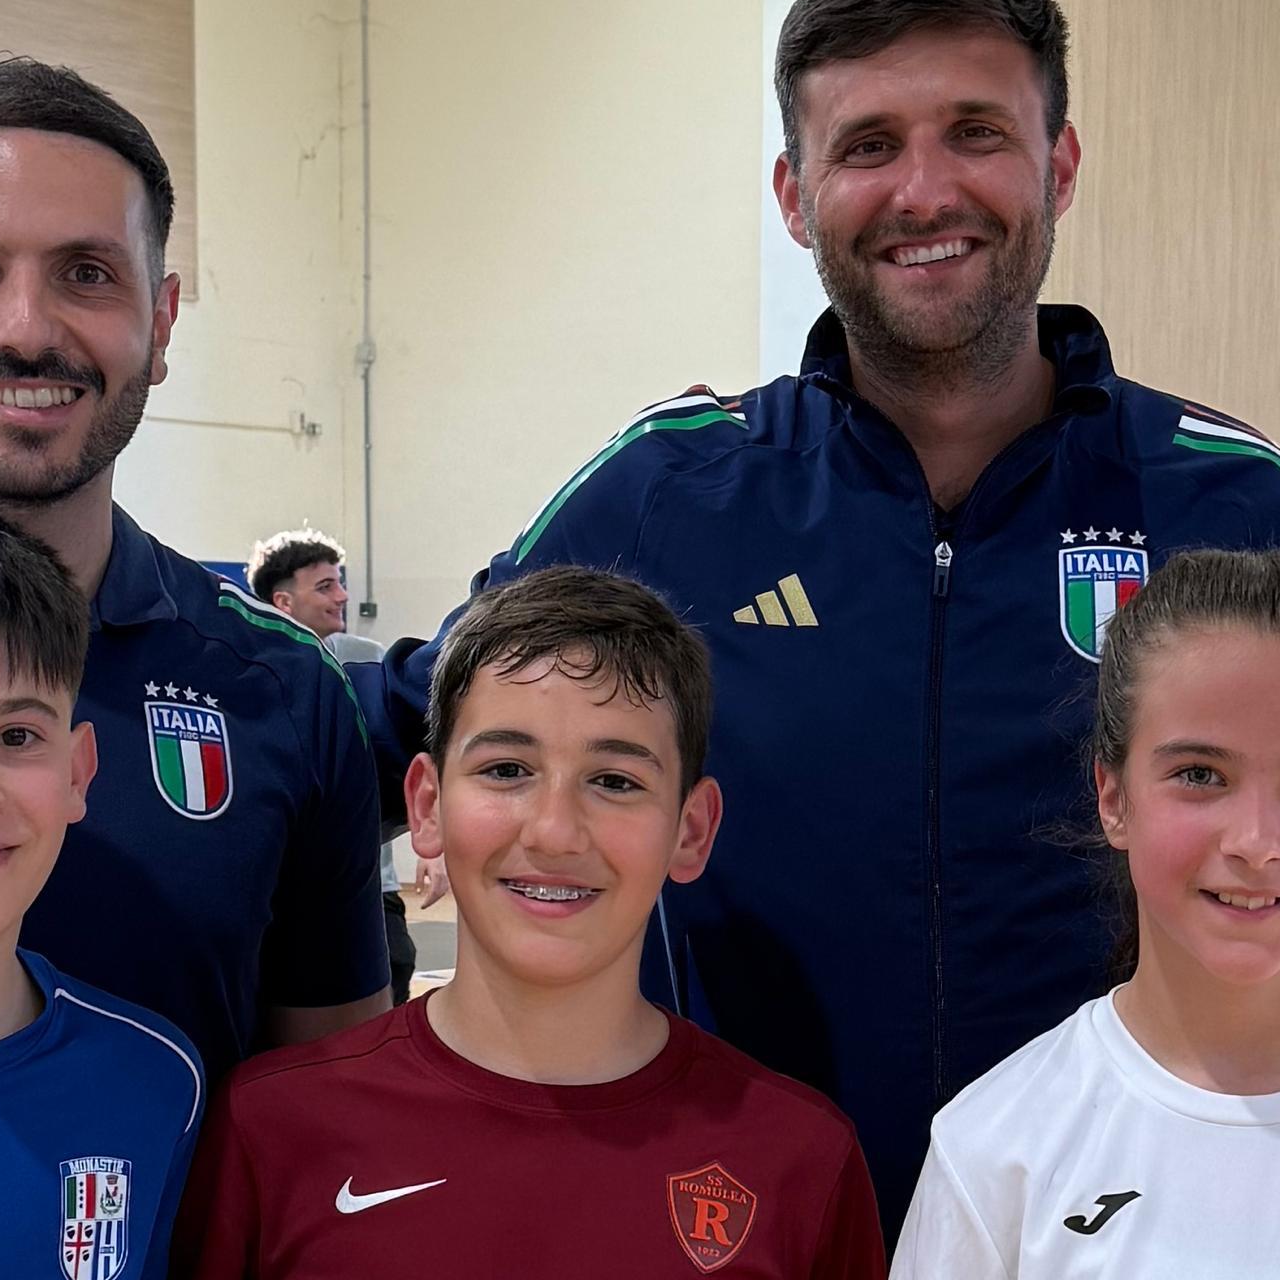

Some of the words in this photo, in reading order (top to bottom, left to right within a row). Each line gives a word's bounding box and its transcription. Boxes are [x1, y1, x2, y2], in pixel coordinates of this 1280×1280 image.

[1066, 554, 1140, 573] ITALIA
[151, 707, 221, 736] ITALIA
[679, 1181, 748, 1204] ROMULEA
[706, 1175, 724, 1187] SS
[689, 1197, 733, 1246] R
